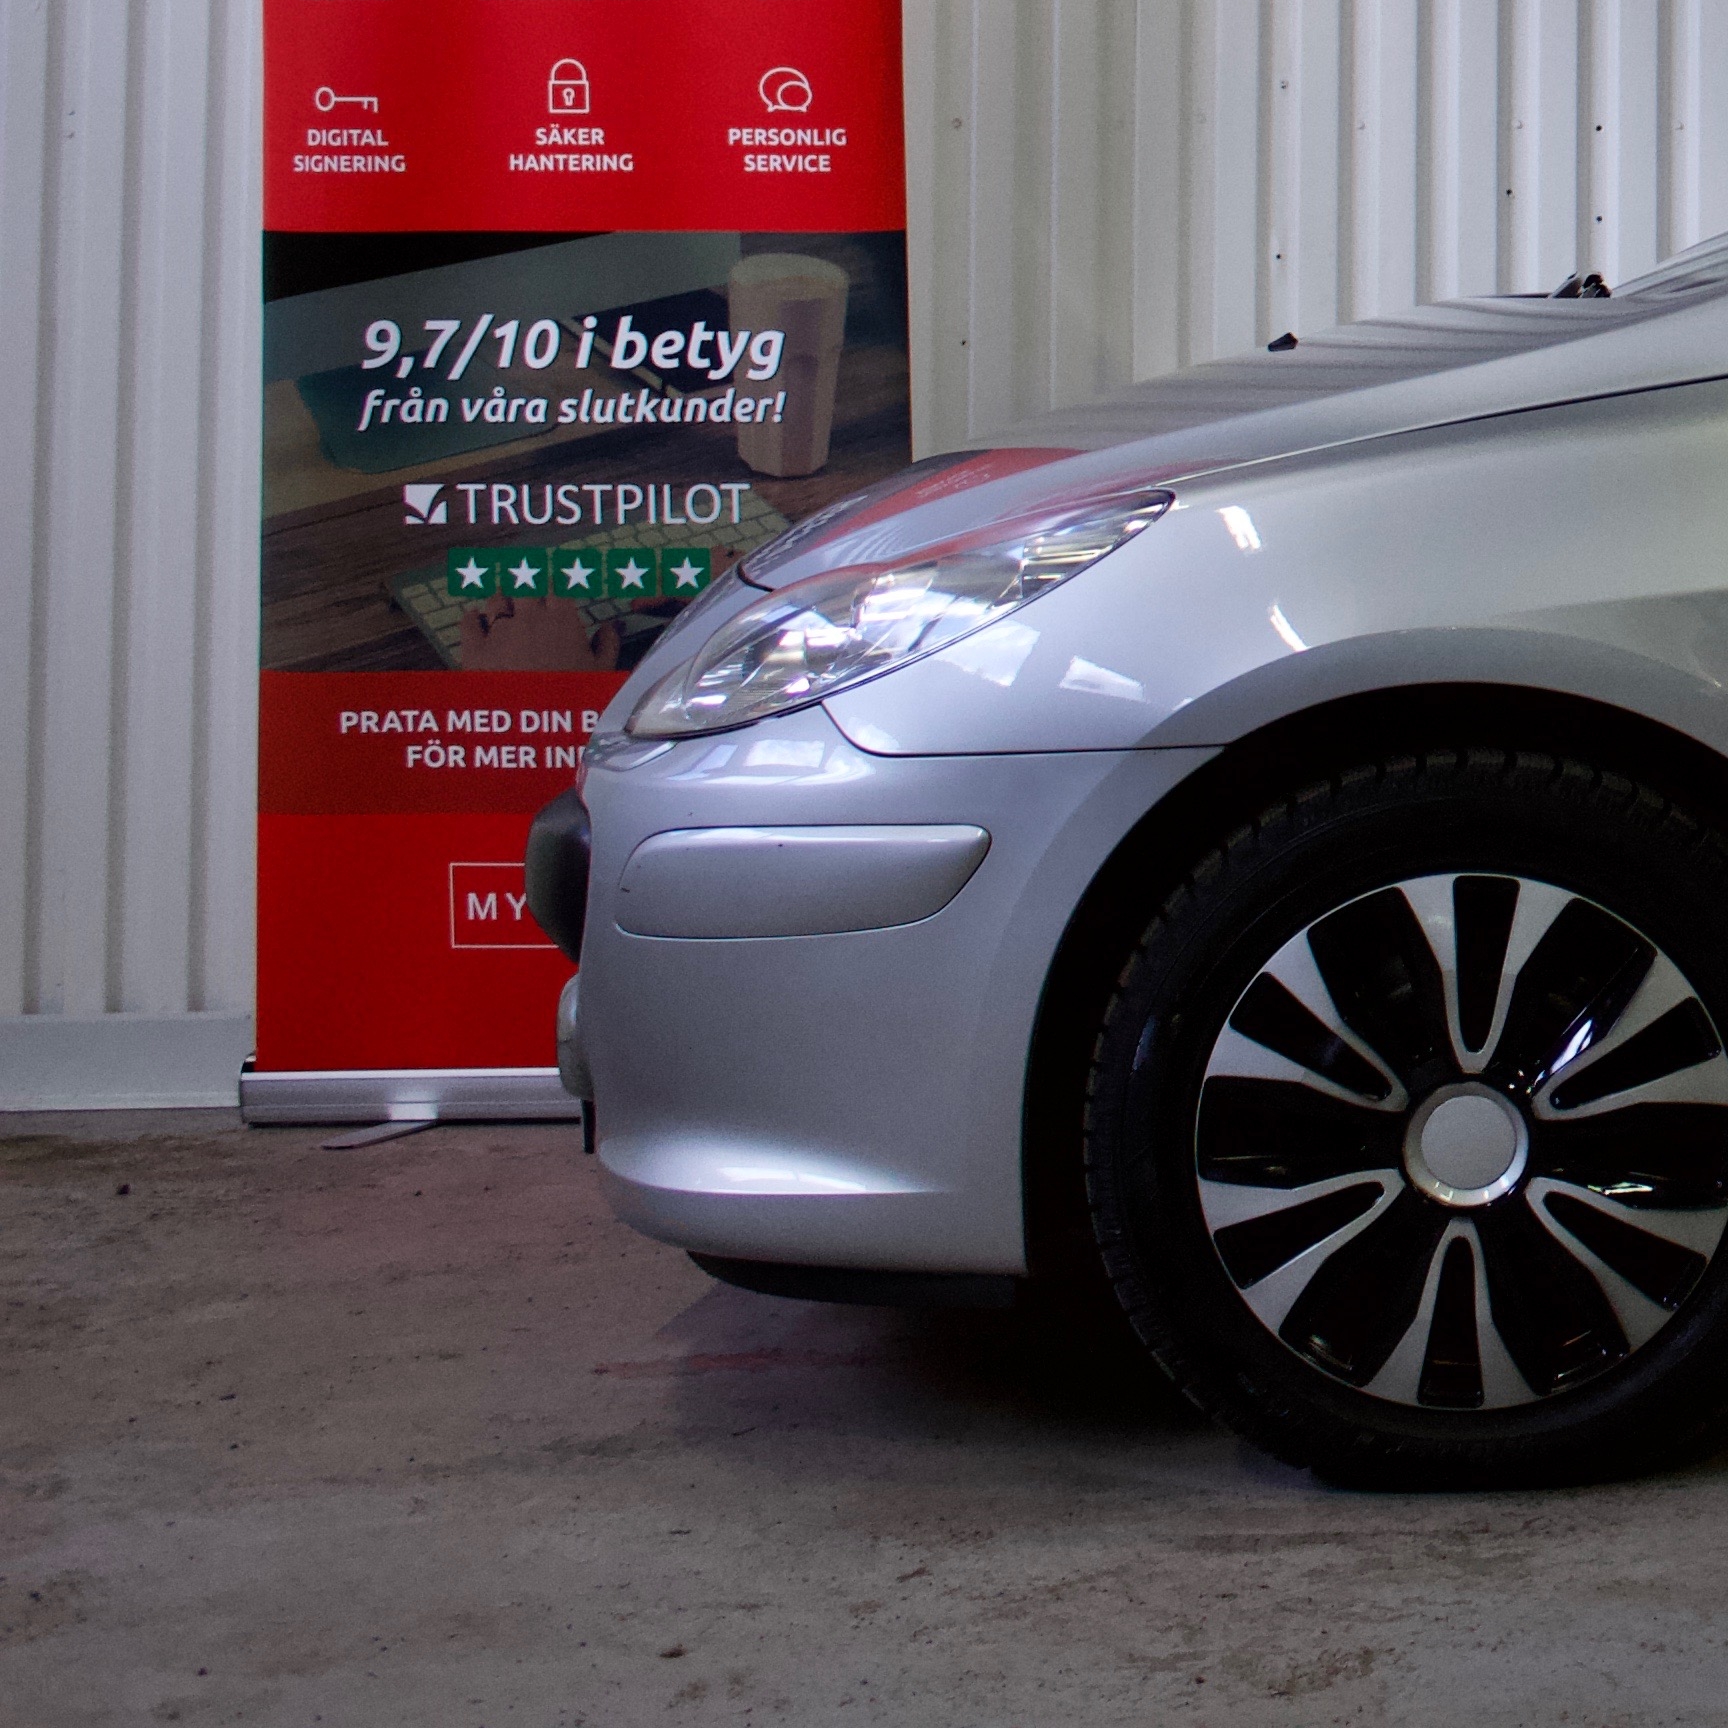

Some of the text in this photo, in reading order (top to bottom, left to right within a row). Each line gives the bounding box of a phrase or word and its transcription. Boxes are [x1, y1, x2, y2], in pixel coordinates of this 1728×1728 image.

[306, 128, 389, 147] DIGITAL
[535, 123, 605, 146] SÄKER
[727, 127, 847, 147] PERSONLIG
[293, 154, 406, 173] SIGNERING
[509, 153, 634, 172] HANTERING
[743, 153, 832, 173] SERVICE
[362, 313, 785, 381] 9,7/10 i betyg
[357, 386, 786, 432] från våra slutkunder!
[456, 482, 751, 525] TRUSTPILOT
[340, 709, 440, 734] PRATA
[447, 709, 512, 733] MED
[519, 709, 572, 734] DIN
[406, 738, 467, 769] FÖR
[474, 745, 537, 769] MER
